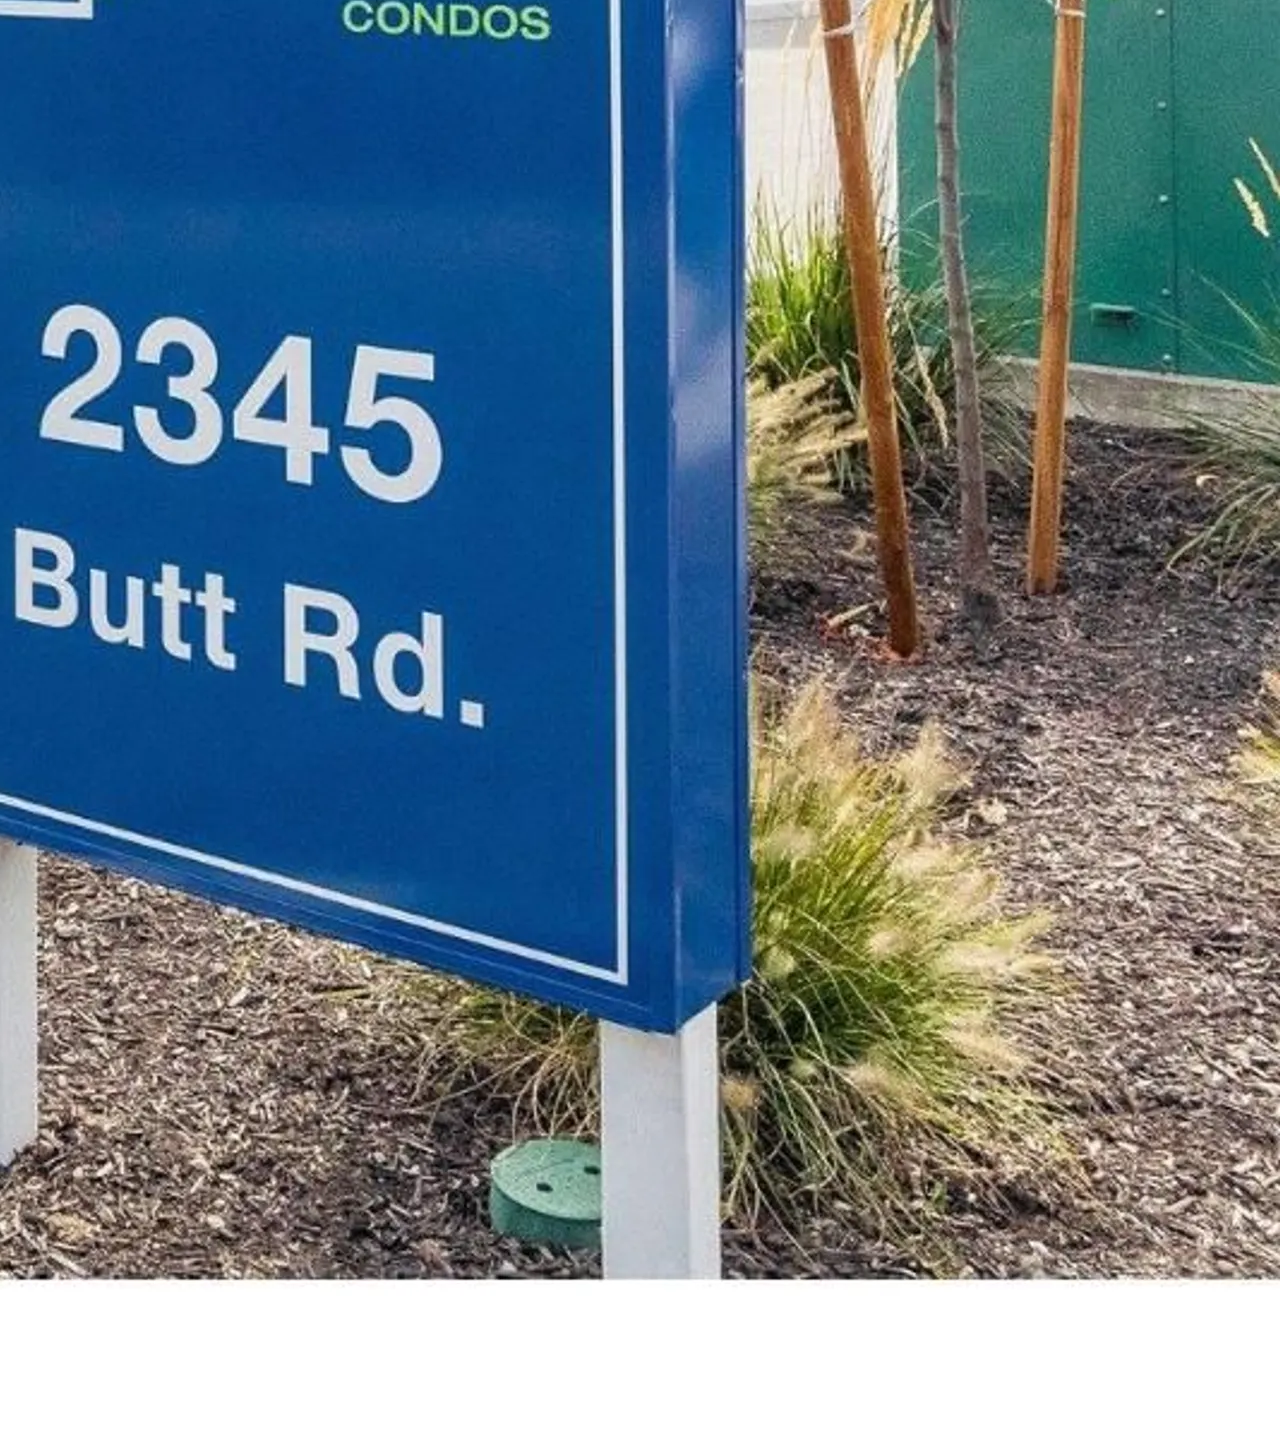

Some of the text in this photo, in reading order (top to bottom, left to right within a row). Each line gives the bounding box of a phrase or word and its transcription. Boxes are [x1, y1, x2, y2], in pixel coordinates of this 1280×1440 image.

[342, 0, 551, 41] CONDOS
[39, 304, 443, 504] 2345
[14, 527, 485, 728] Butt Rd.
